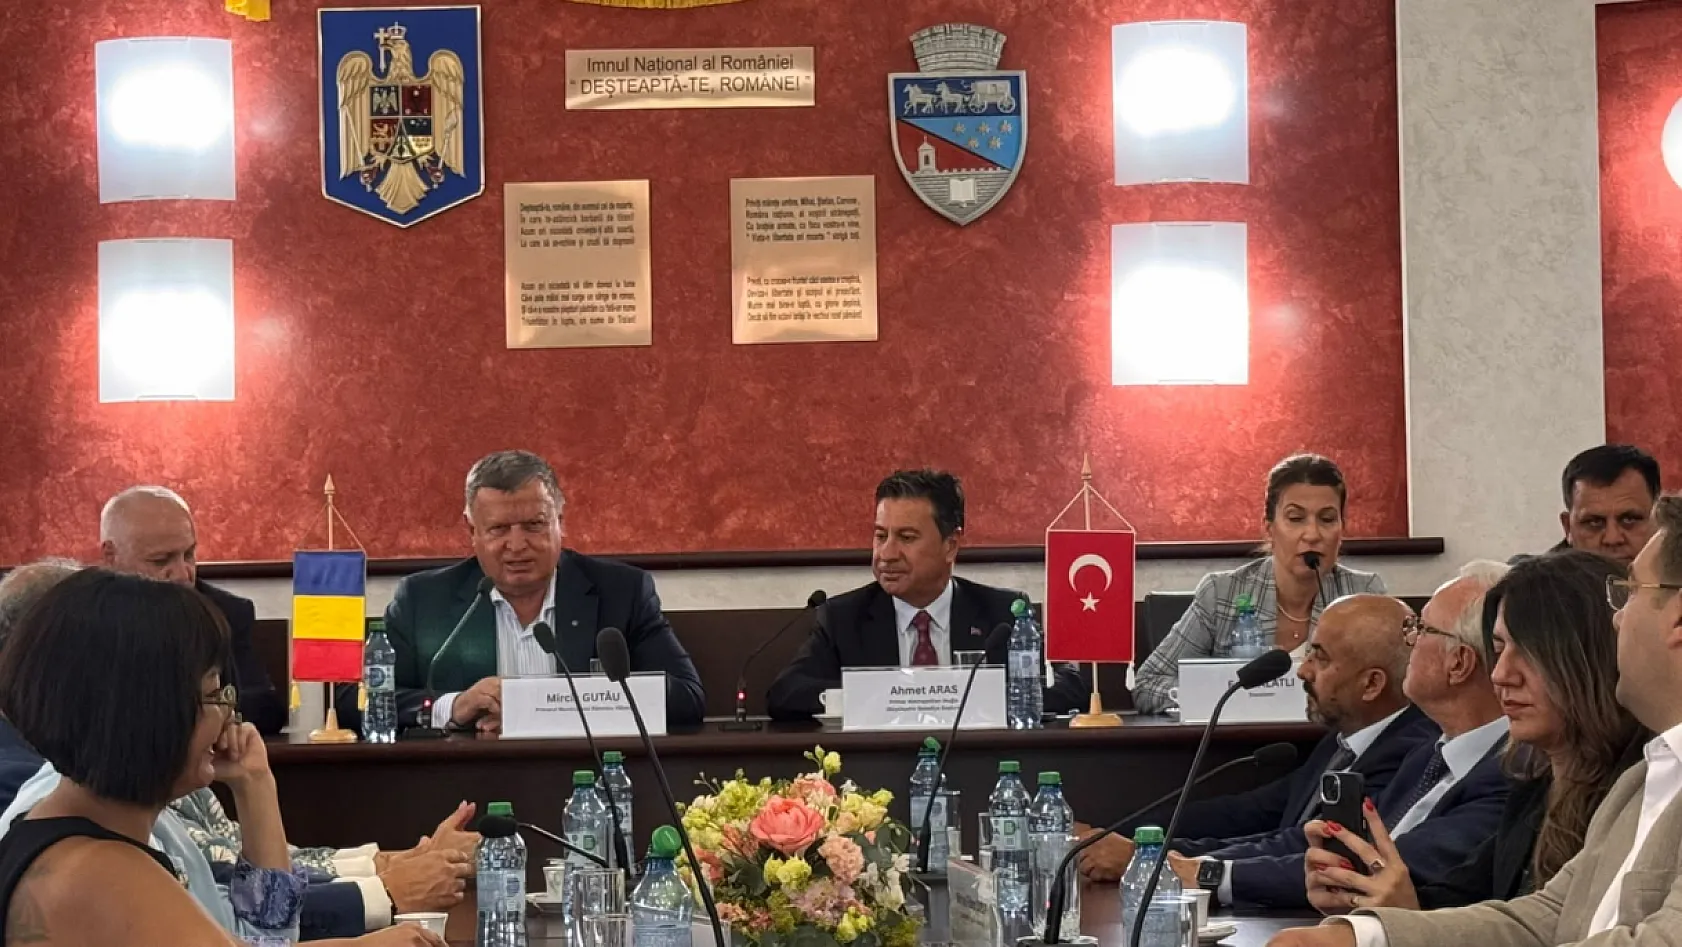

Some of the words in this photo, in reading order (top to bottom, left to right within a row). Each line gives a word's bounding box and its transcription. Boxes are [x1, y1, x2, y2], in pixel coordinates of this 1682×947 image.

[587, 57, 629, 72] Imnul
[634, 55, 697, 75] Național
[702, 54, 715, 71] al
[720, 53, 794, 71] României
[890, 685, 926, 696] Ahmet
[929, 684, 958, 694] ARAS
[546, 692, 580, 704] Mirc
